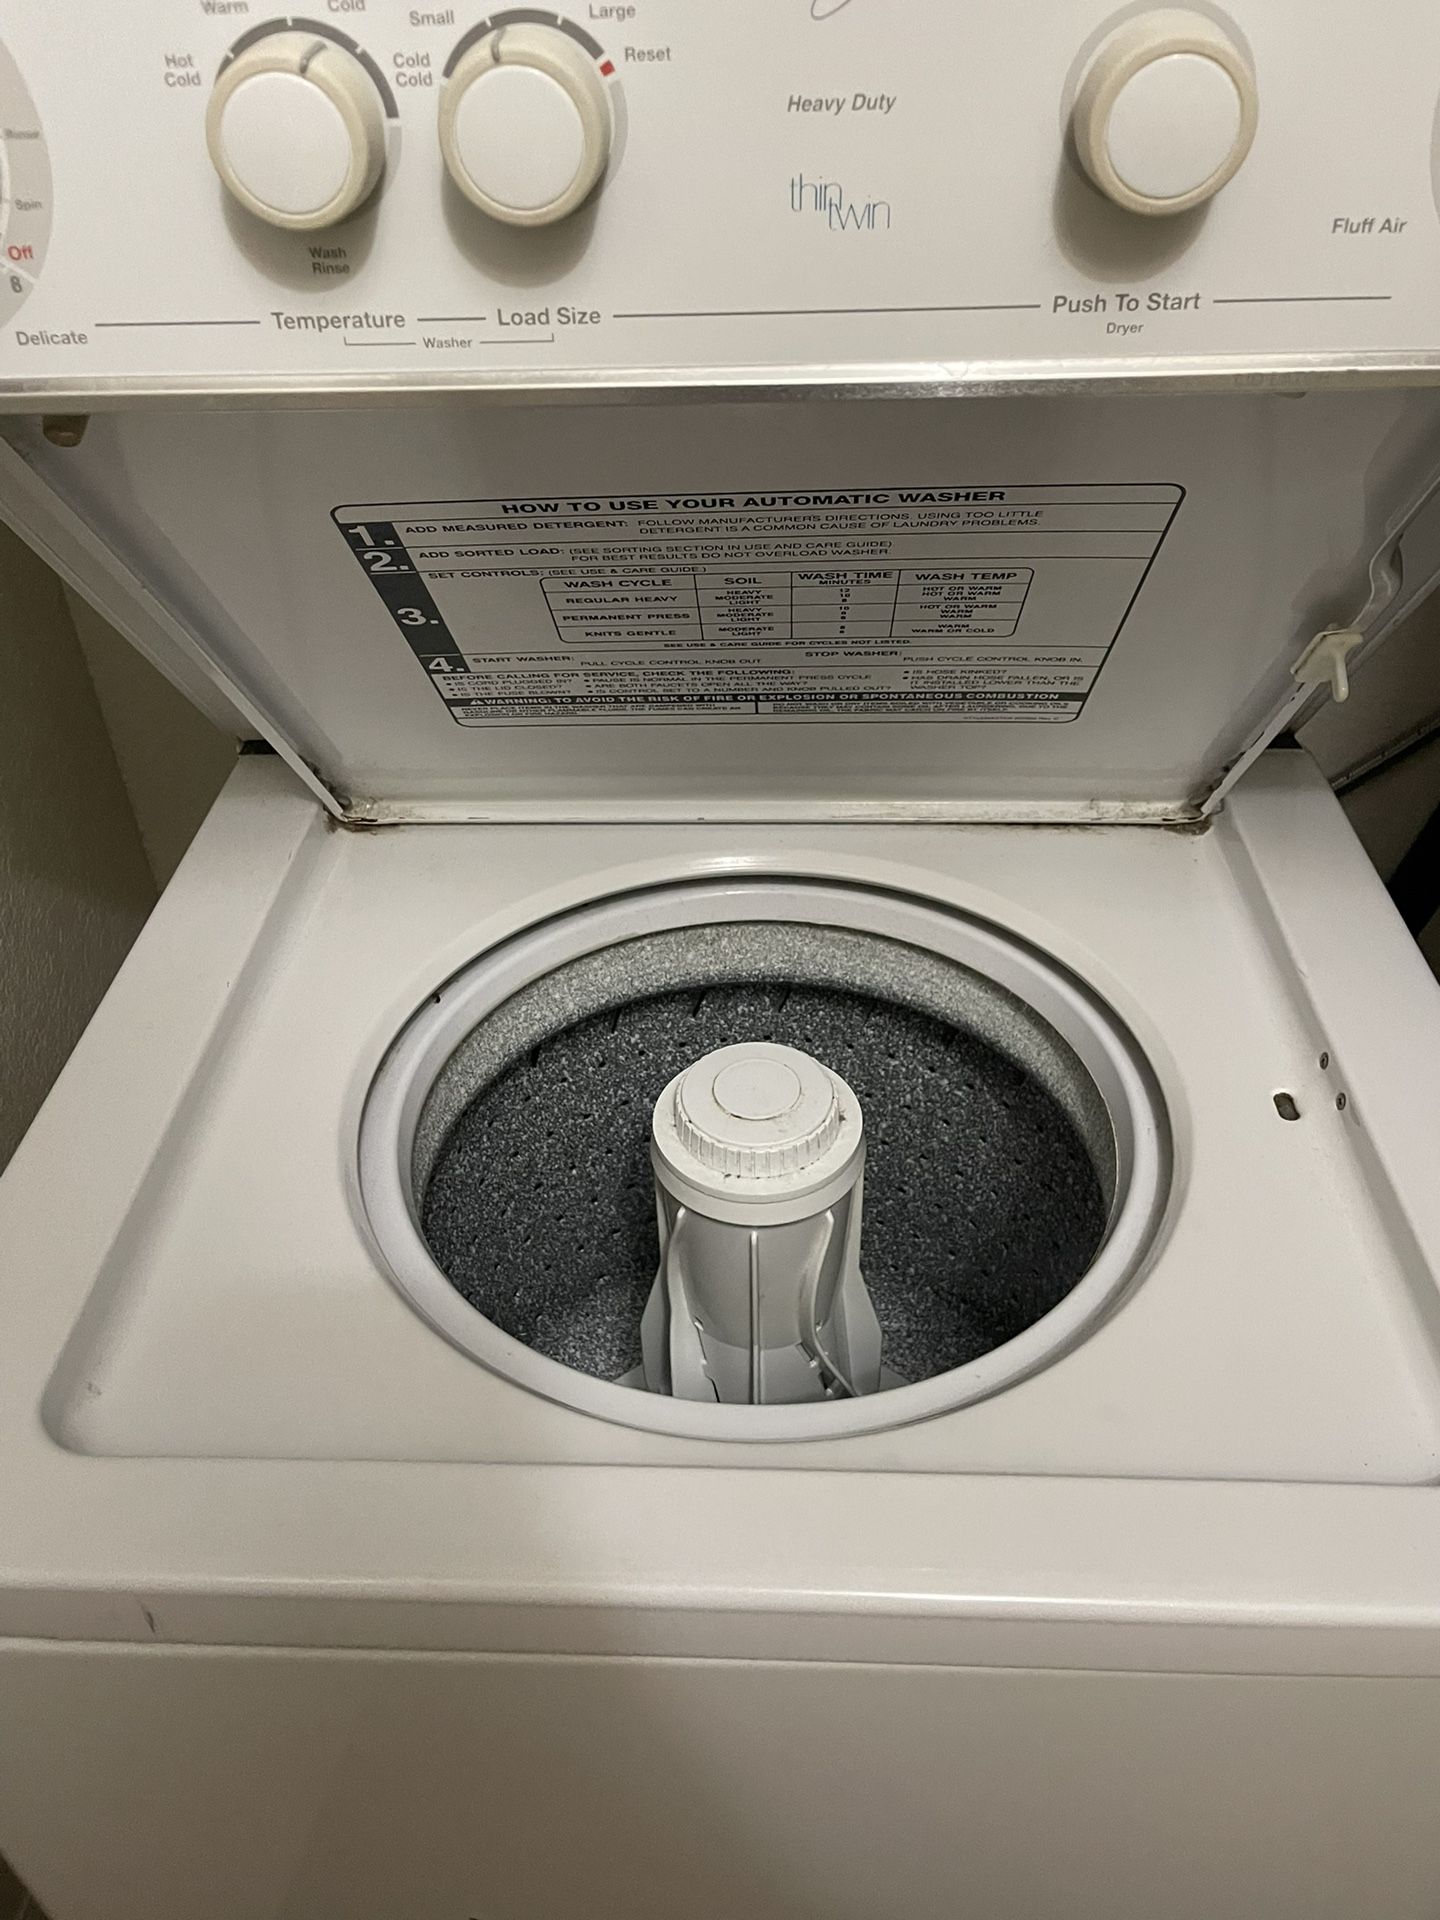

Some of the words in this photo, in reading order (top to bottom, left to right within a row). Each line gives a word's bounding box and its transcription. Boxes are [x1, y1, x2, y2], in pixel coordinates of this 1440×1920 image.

[201, 0, 249, 15] Warm
[588, 4, 636, 22] Large
[409, 10, 455, 26] Small
[164, 54, 193, 68] Hot
[393, 53, 430, 68] Cold
[624, 47, 672, 62] Reset
[164, 72, 201, 88] Cold
[395, 72, 433, 87] Cold
[787, 95, 846, 116] Heavy
[852, 93, 897, 114] Duty
[789, 173, 842, 212] thin
[15, 199, 42, 211] Spin
[828, 195, 891, 231] twin
[1331, 218, 1375, 234] Fluff
[1378, 218, 1408, 234] Air
[7, 245, 33, 261] Off
[309, 247, 347, 259] Wash
[312, 262, 350, 274] Rinse
[10, 275, 22, 293] 8
[1053, 295, 1106, 313] Push
[1115, 294, 1140, 312] To
[1146, 293, 1201, 311] Start
[270, 312, 406, 332] Temperature
[497, 308, 550, 326] Load
[556, 307, 601, 325] Size
[1106, 322, 1144, 337] Dryer
[15, 331, 88, 346] Delicate
[422, 336, 473, 349] Washer
[502, 503, 559, 514] HOW
[567, 502, 601, 512] TO
[609, 501, 658, 511] USE
[665, 498, 735, 509] YOUR
[742, 494, 890, 507] AUTOMATIC
[898, 491, 1006, 504] WASHER
[442, 523, 528, 533] MEASURED
[533, 520, 629, 530] DETERGENT:
[638, 519, 695, 527] FOLLOW
[999, 510, 1044, 518] LITTLE
[639, 526, 721, 535] DETERGENT
[753, 523, 816, 531] COMMON
[893, 520, 958, 528] LAUNDRY
[348, 525, 395, 547] 1.
[454, 549, 514, 558] SORTED
[520, 548, 565, 556] LOAD:
[569, 547, 599, 555] (SEE
[363, 551, 409, 572] 2.
[461, 570, 544, 578] CONTROLS:
[724, 577, 762, 585] SOIL
[915, 573, 965, 581] WASH
[971, 572, 1017, 580] TEMP
[618, 579, 673, 587] CYCLE
[397, 607, 439, 625] 3.
[428, 657, 465, 672] 4.
[484, 697, 551, 705] WARNING:
